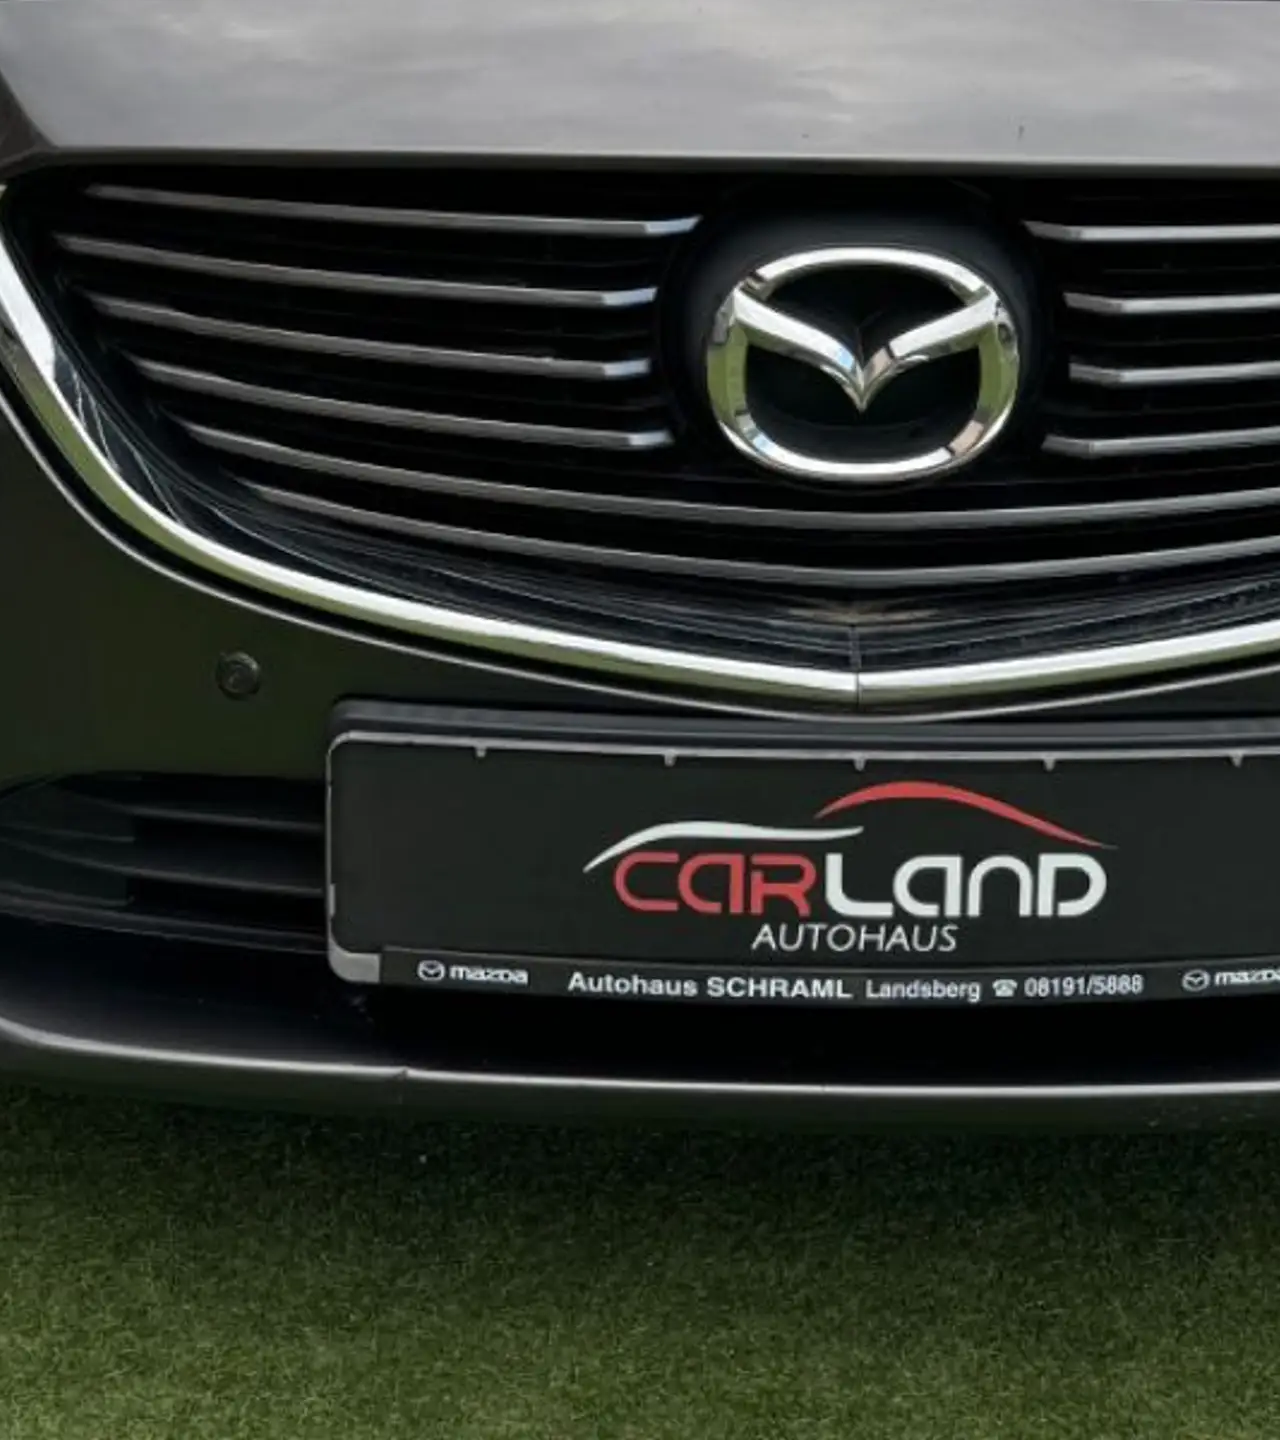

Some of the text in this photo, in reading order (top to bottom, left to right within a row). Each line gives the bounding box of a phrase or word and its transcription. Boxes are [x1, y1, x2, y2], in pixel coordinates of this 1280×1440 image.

[614, 852, 1108, 917] CARLAND
[751, 922, 959, 952] AUTOHAUS
[568, 971, 699, 998] Autohaus
[707, 976, 853, 1000] SCHRAML
[865, 979, 981, 1003] Landsberg
[1024, 974, 1144, 997] 08191/5888
